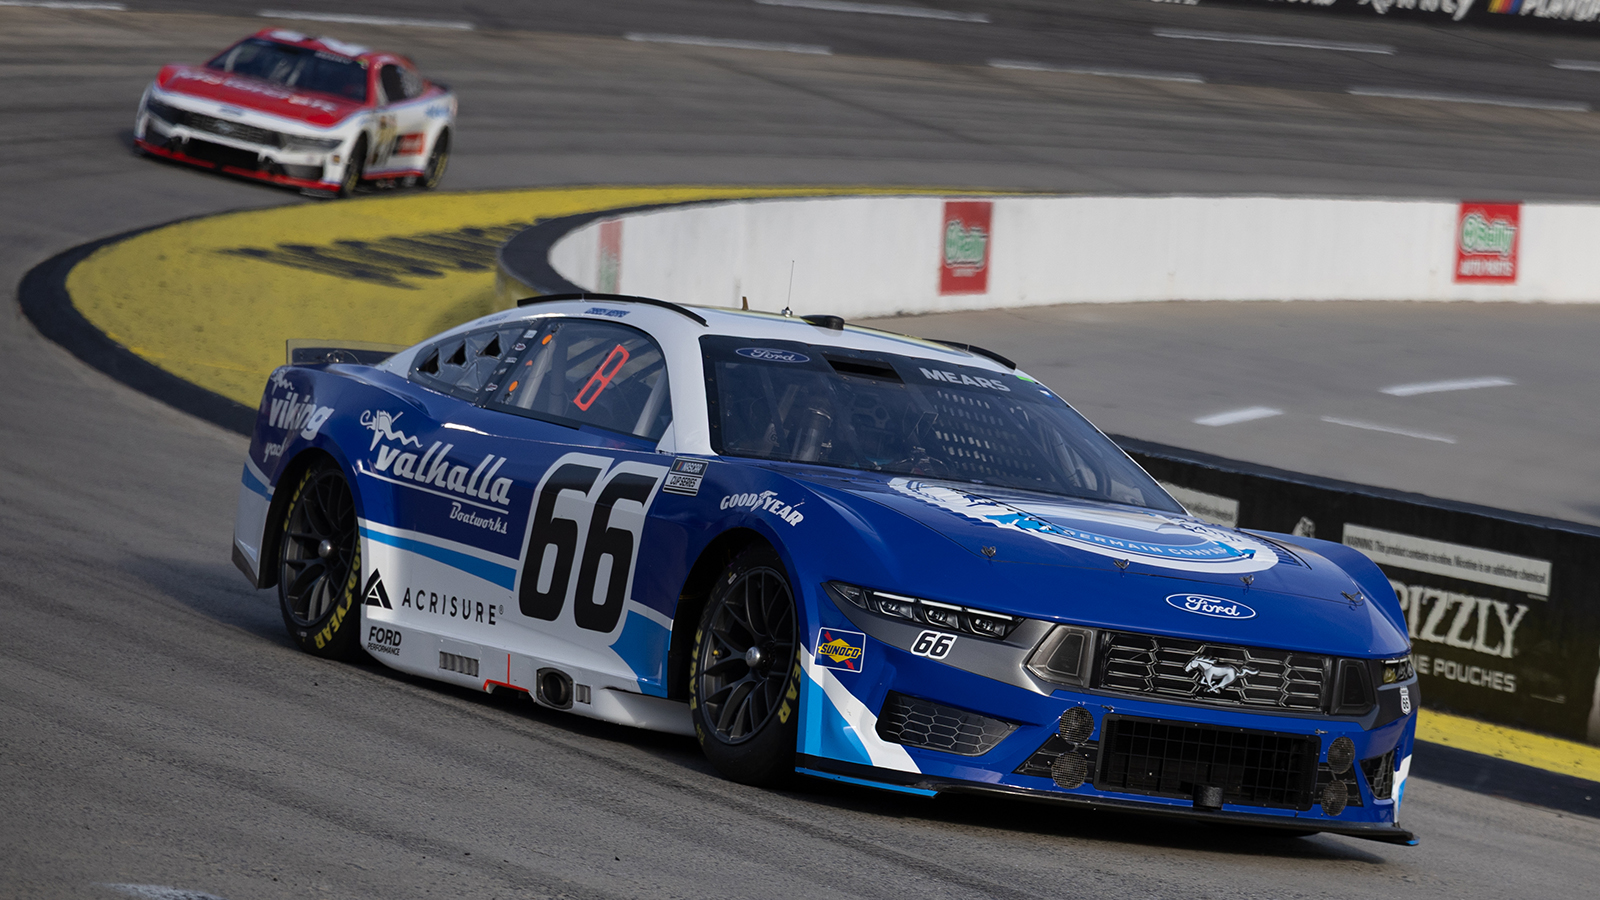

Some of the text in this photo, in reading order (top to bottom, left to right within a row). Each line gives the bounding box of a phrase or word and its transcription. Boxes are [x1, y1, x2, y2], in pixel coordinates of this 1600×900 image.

[750, 348, 797, 361] Ford
[918, 366, 1011, 392] MEARS
[268, 391, 335, 441] viking
[375, 440, 514, 506] valhalla
[449, 502, 508, 535] Boatworks
[719, 489, 804, 527] GOODYEAR
[518, 462, 660, 634] 66
[1185, 595, 1240, 616] Ford
[367, 641, 401, 656] PERFORMANCE
[368, 625, 402, 647] FORD
[911, 631, 957, 659] 66
[820, 643, 860, 660] SUNOCO
[1433, 657, 1517, 693] POUCHES
